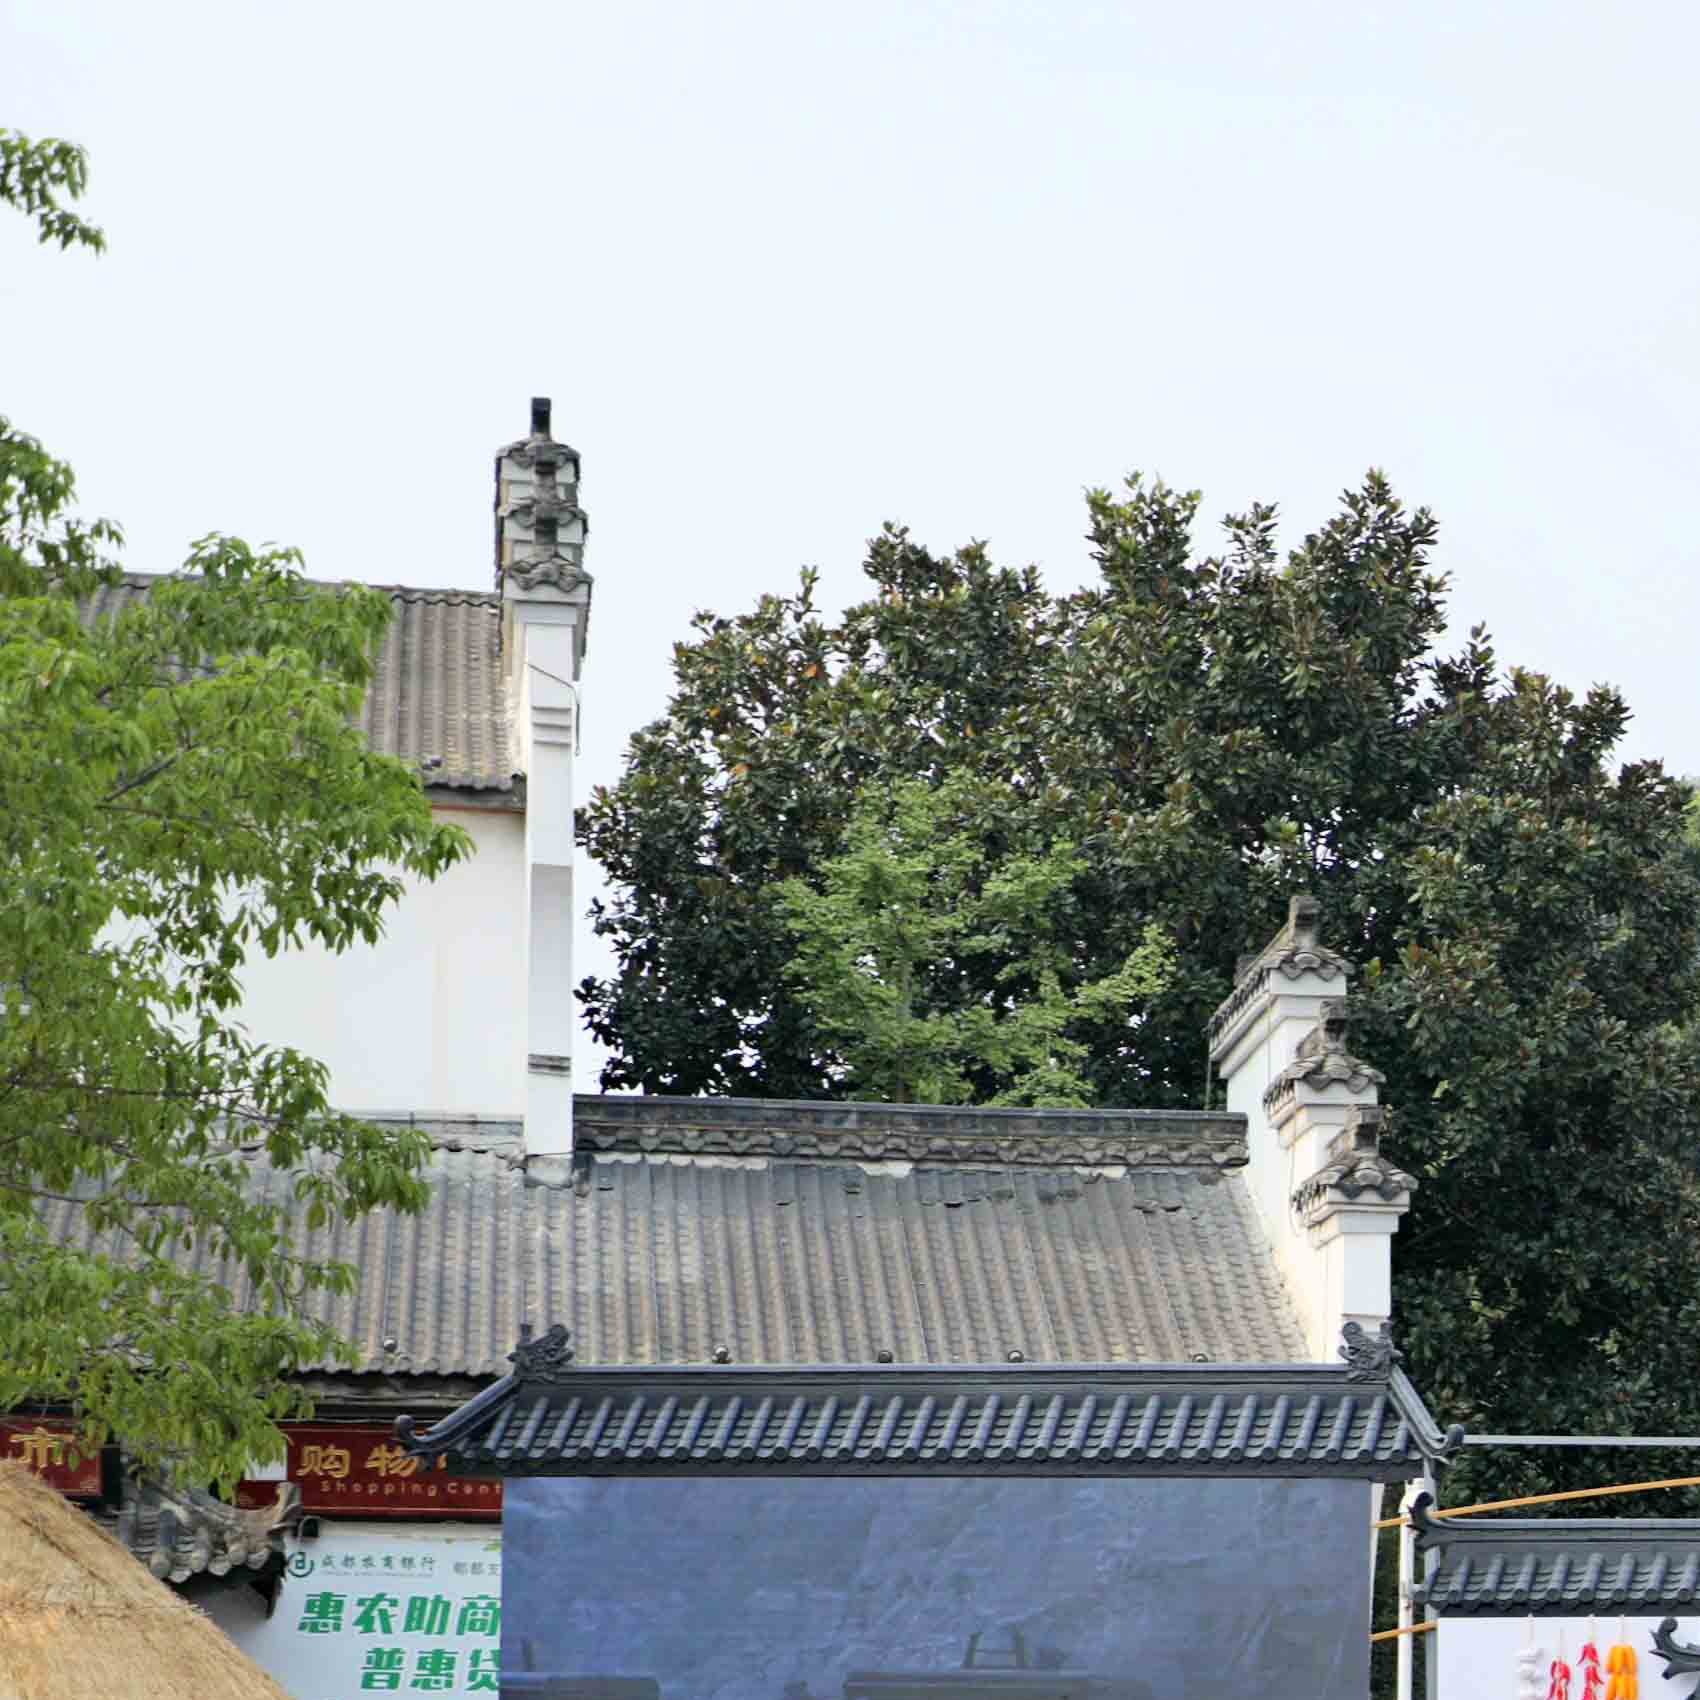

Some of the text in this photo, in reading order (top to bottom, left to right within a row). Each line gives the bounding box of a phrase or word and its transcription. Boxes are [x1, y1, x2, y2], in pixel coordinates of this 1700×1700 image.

[296, 1444, 448, 1478] 购物
[320, 1479, 438, 1497] Shopping
[297, 1591, 500, 1637] 惠农助商
